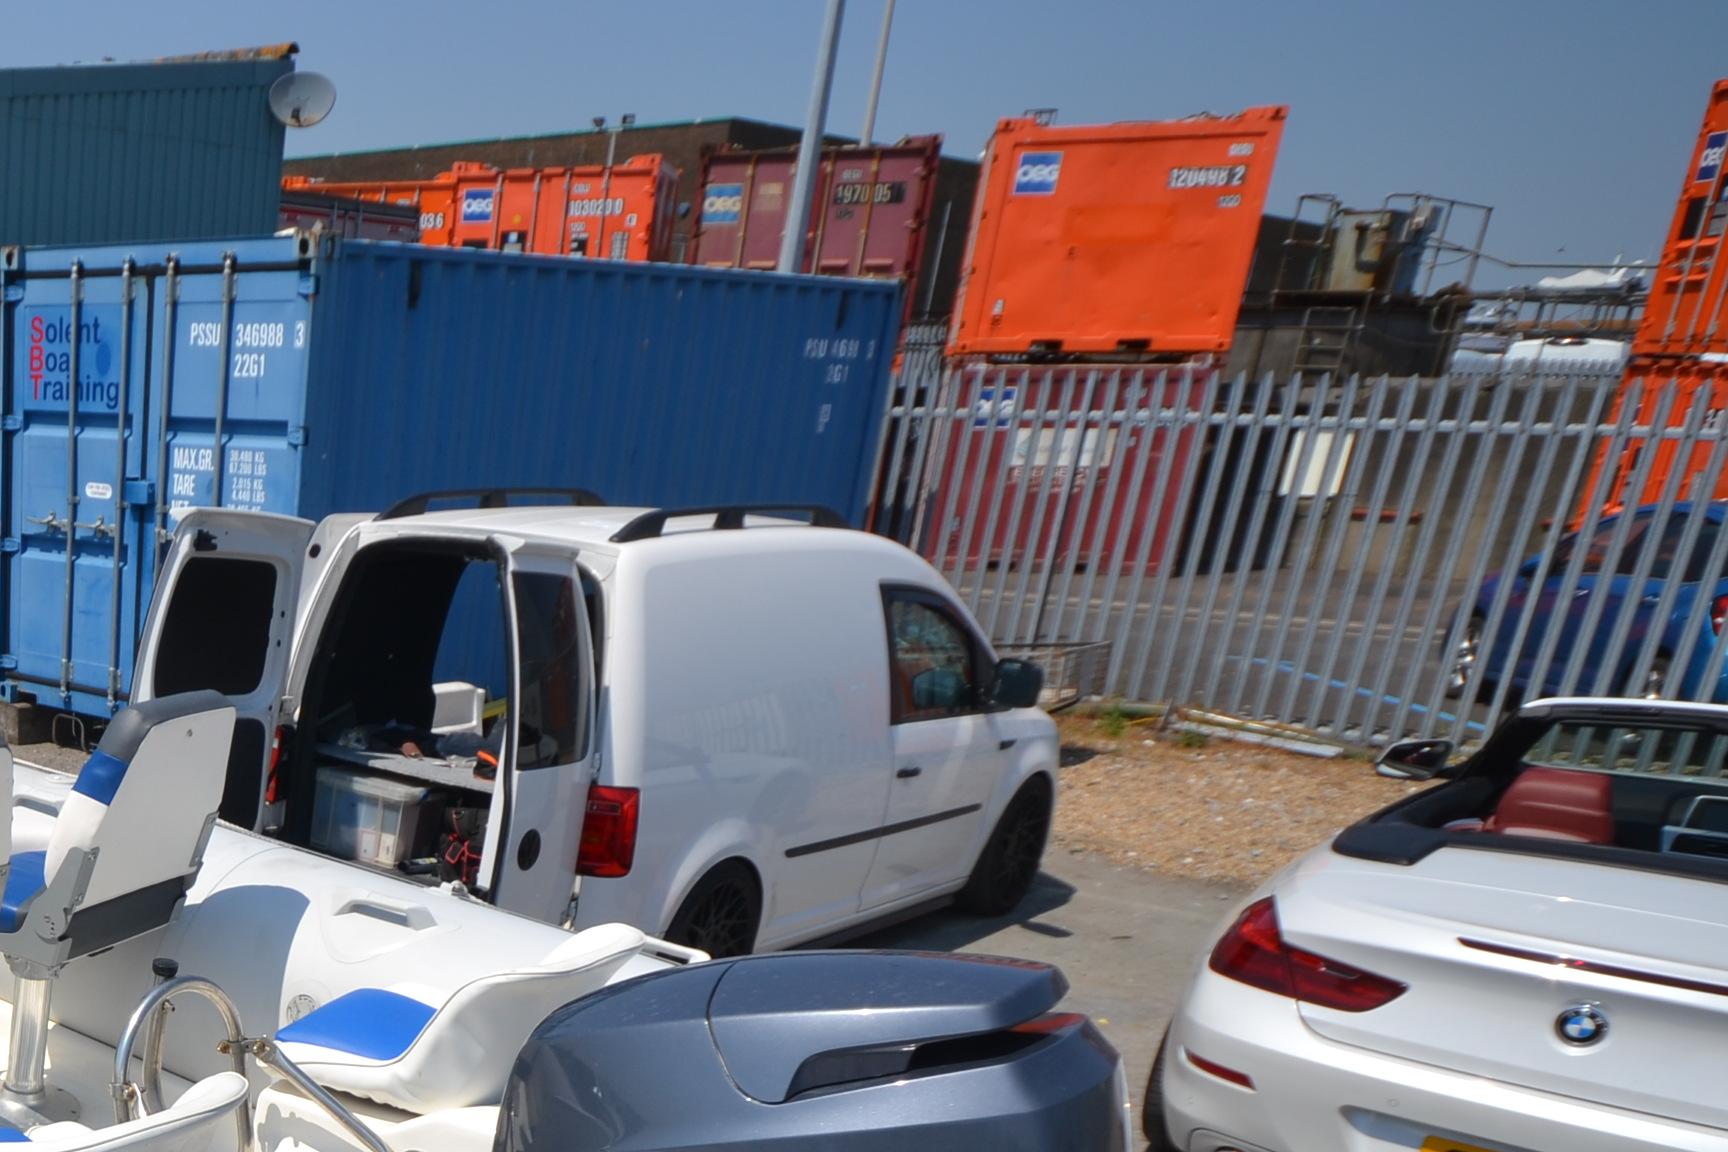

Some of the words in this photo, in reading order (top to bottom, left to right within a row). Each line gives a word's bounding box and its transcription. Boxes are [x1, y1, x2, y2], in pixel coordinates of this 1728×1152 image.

[31, 315, 101, 344] Solent
[190, 322, 221, 346] PSSU
[235, 322, 284, 347] 346988
[294, 321, 305, 348] 3
[30, 344, 73, 373] Boa
[233, 353, 266, 378] 22G1
[174, 448, 214, 470] MAX.GR.
[255, 451, 265, 463] KG
[254, 463, 267, 476] LBS
[173, 473, 195, 496] TARE
[253, 478, 263, 490] KG
[252, 490, 265, 503] LBS
